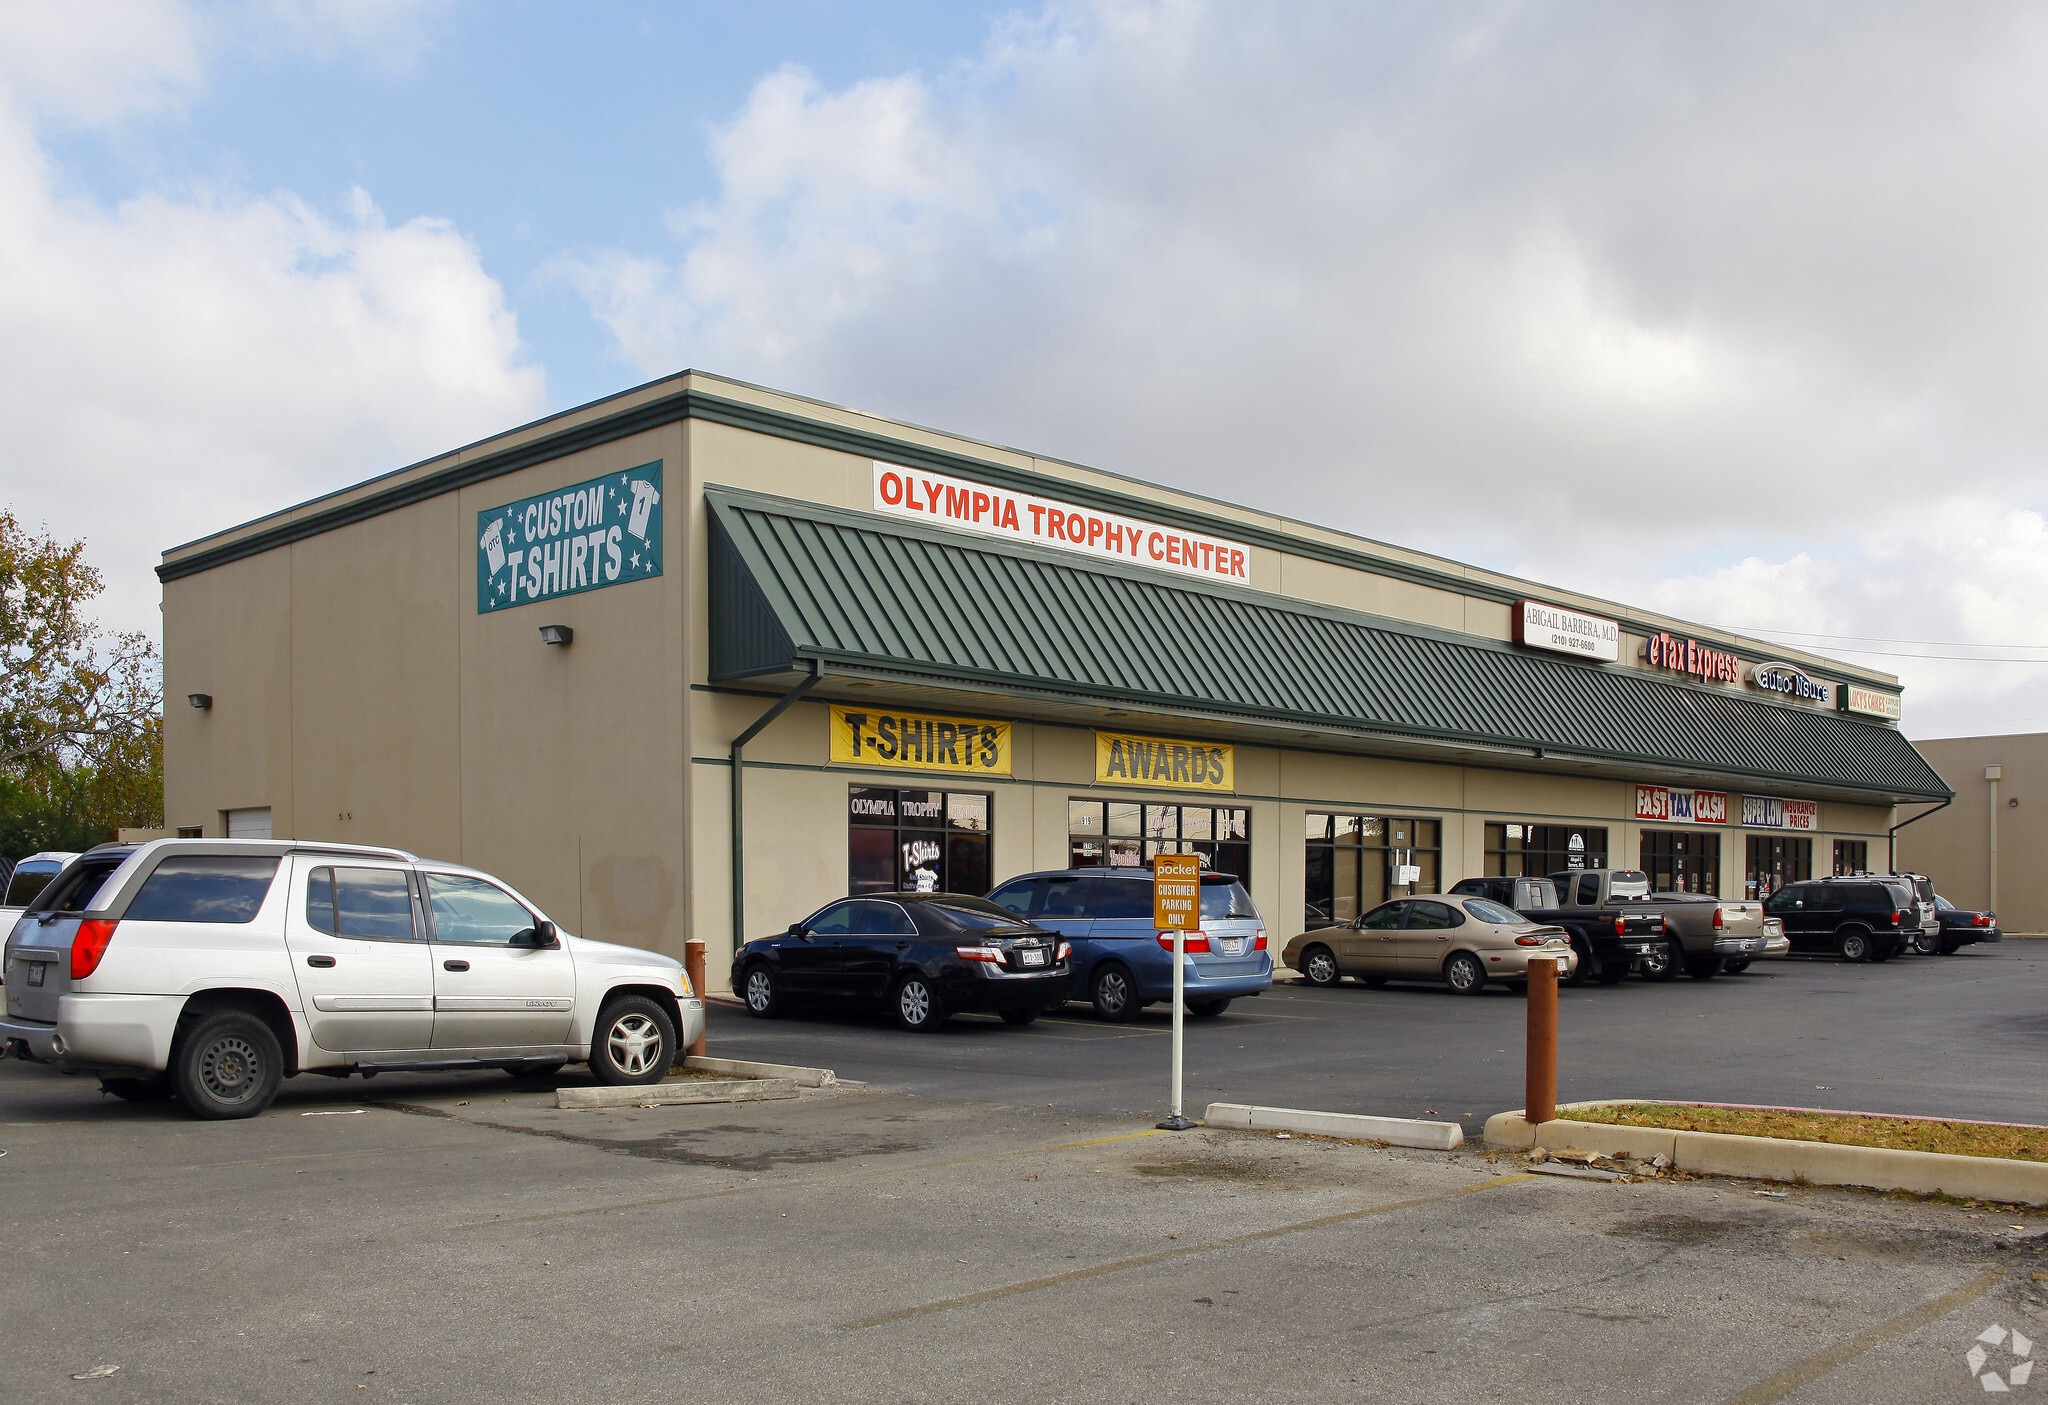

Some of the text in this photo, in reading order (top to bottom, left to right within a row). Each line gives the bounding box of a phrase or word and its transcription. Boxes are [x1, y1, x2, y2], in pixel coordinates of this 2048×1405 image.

[524, 484, 605, 543] CUSTOM
[638, 495, 646, 516] 1
[879, 471, 1246, 579] OLYMPIA TROPHY CENTER
[488, 535, 500, 551] OTC
[507, 525, 623, 602] T-SHIRTS
[1526, 607, 1618, 643] ABIGAIL BARRERA, M.D.
[1551, 633, 1567, 647] (210)
[1687, 638, 1740, 684] Express
[844, 712, 999, 768] T-SHIRTS
[1106, 739, 1224, 785] AWARDS
[850, 798, 984, 820] OLYMPIA TROPHY CENTER
[1670, 792, 1692, 818] TAX
[1742, 797, 1782, 826] SUPER LOW
[1783, 800, 1816, 816] INSURANCE
[1789, 814, 1810, 829] PRICES
[901, 839, 941, 873] T-Shirts
[1157, 864, 1197, 877] pocket
[1158, 884, 1196, 897] CUSTOMER
[1161, 898, 1192, 911] PARKING
[1168, 913, 1186, 925] ONLY
